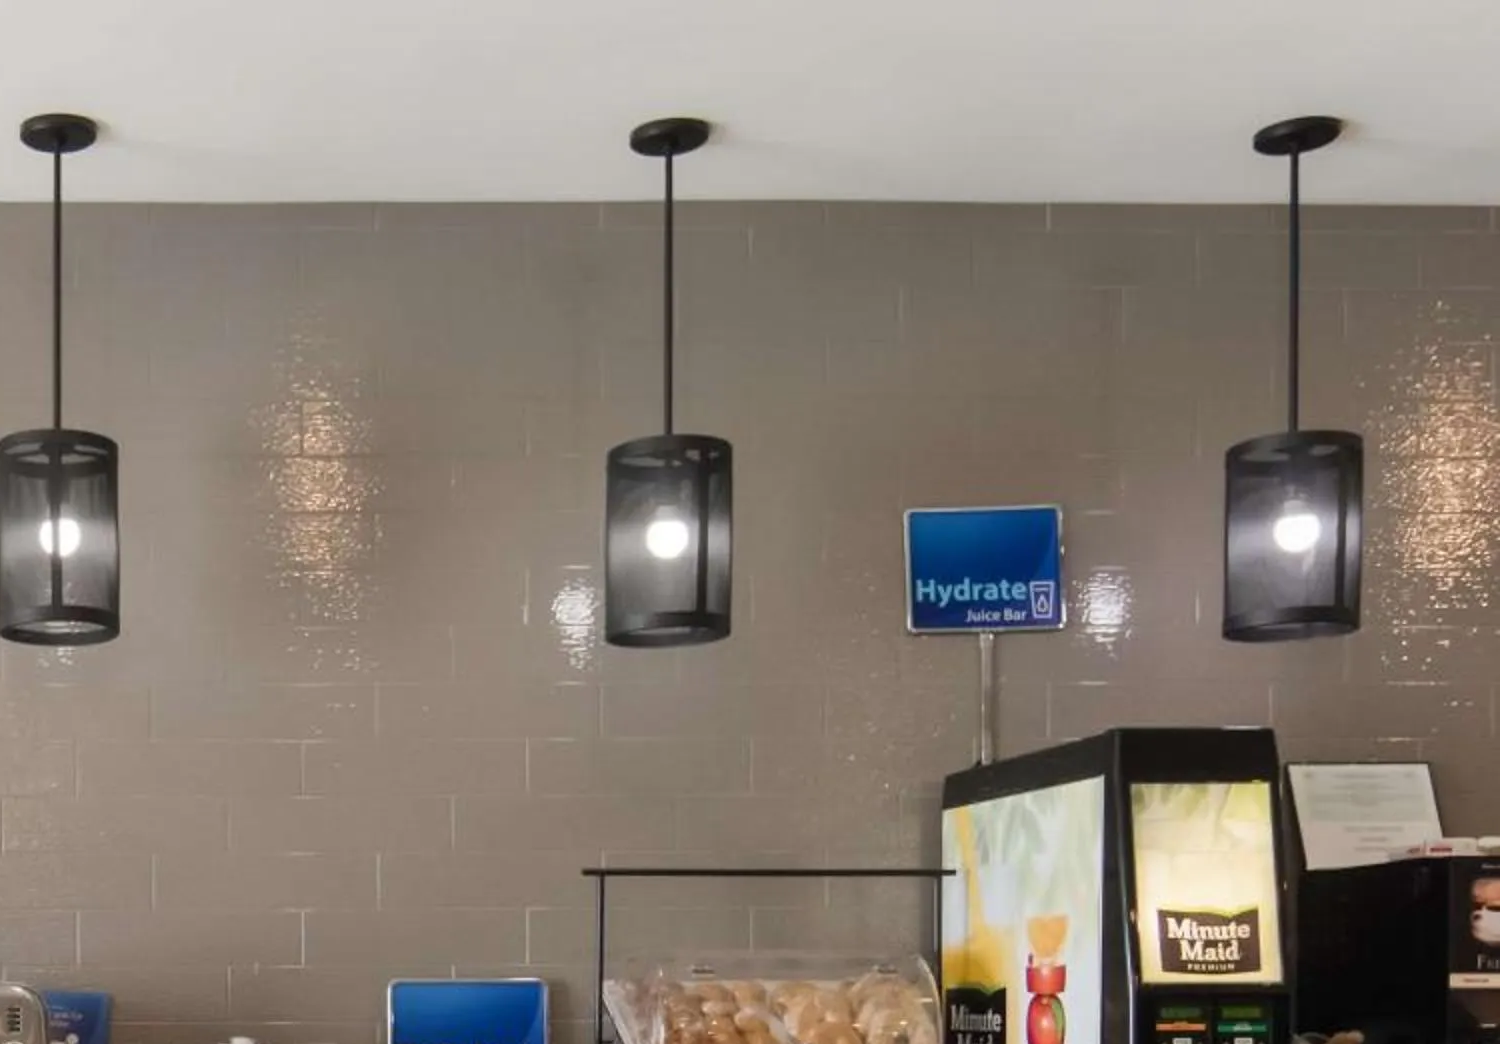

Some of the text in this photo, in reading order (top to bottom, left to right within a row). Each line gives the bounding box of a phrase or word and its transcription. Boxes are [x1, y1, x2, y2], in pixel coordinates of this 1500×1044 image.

[915, 577, 1029, 608] Hydrate
[965, 608, 1028, 622] Juice Bar
[1166, 917, 1251, 941] Minute
[1180, 939, 1241, 961] Maid
[950, 1004, 1002, 1032] Minute
